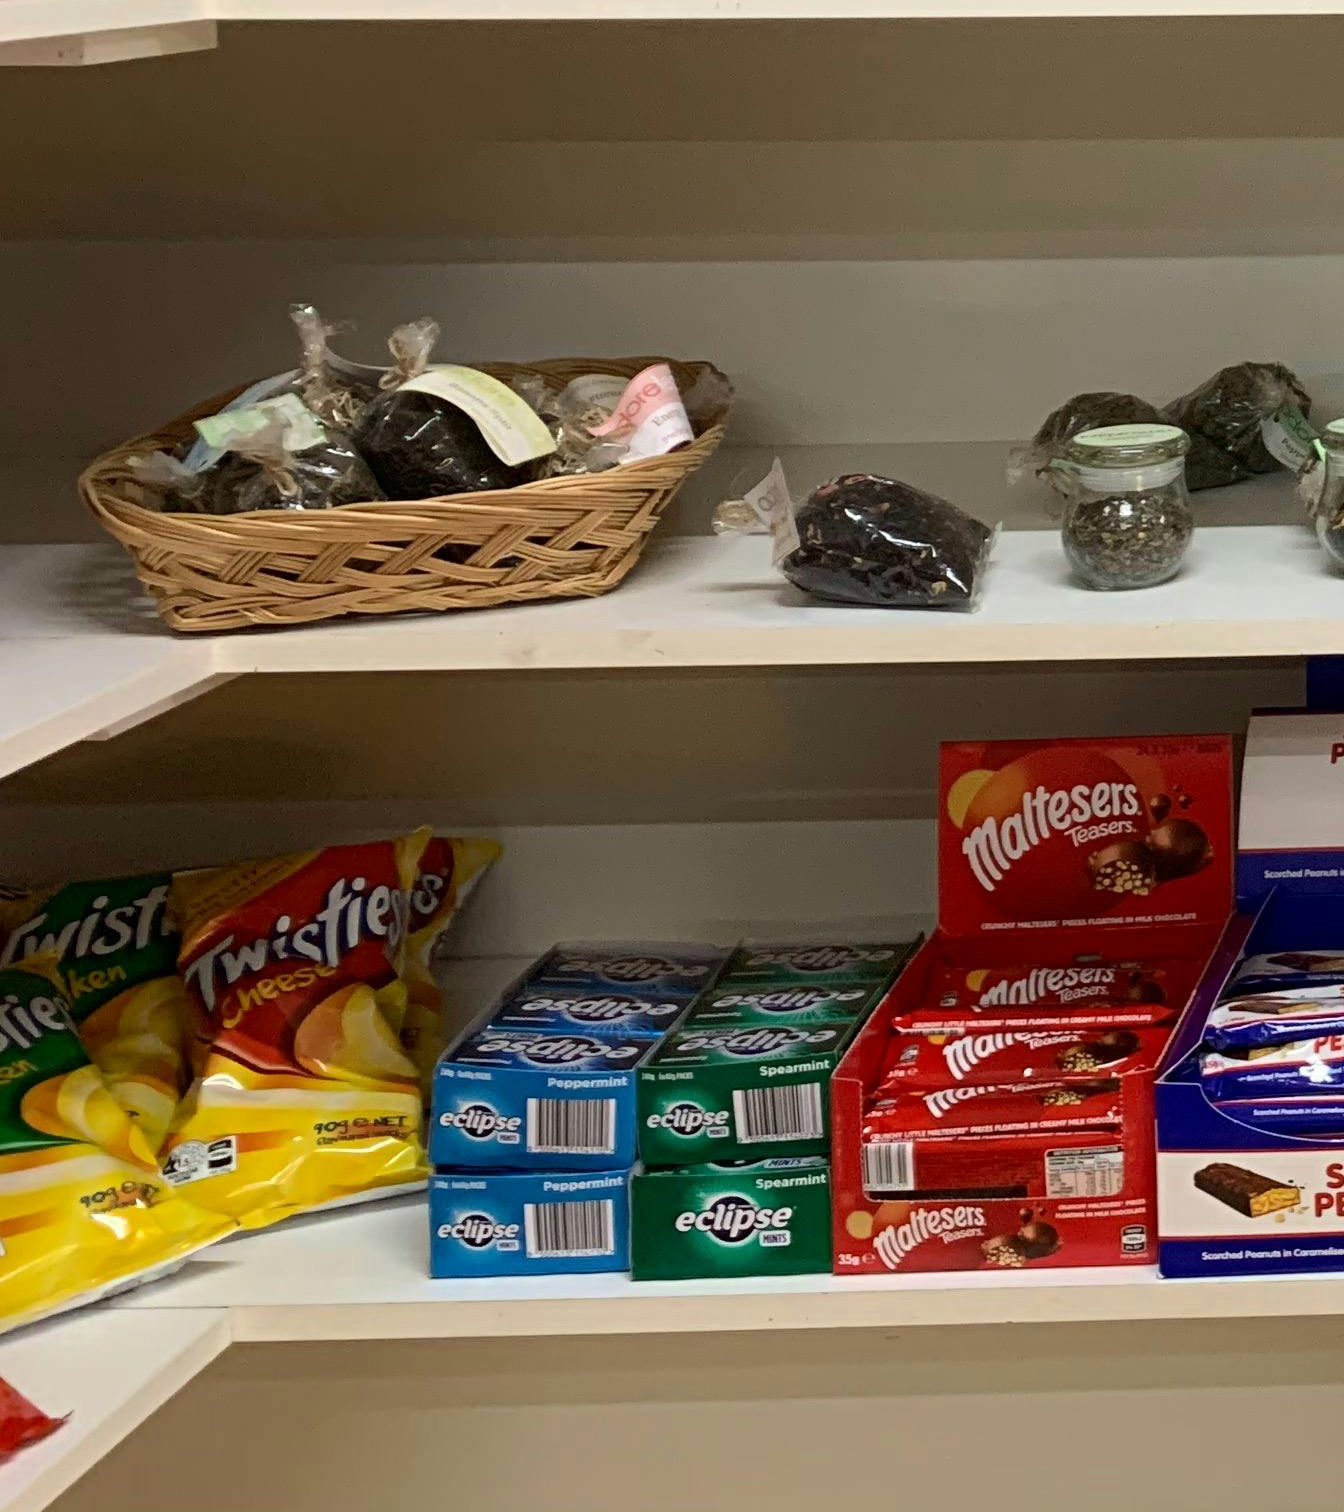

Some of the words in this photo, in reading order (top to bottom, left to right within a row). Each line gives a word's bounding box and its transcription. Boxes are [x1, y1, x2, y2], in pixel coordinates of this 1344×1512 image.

[962, 781, 1139, 892] Maltesers
[1064, 819, 1135, 849] Teasers
[1056, 986, 1109, 1003] Teasers
[759, 1059, 830, 1077] Spearmint
[547, 1076, 628, 1091] Peppermint
[439, 1108, 521, 1139] eclipse
[646, 1106, 730, 1136] eclipse
[543, 1176, 624, 1194] Peppermint
[755, 1174, 827, 1190] Spearmint
[675, 1198, 793, 1241] eclipse
[437, 1215, 519, 1246] eclipse
[873, 1205, 986, 1270] Maltesers
[941, 1227, 984, 1244] Teasers
[837, 1253, 860, 1266] 35g
[1201, 1250, 1243, 1261] Scorched
[1245, 1248, 1281, 1259] Peanuts
[1283, 1248, 1292, 1257] in
